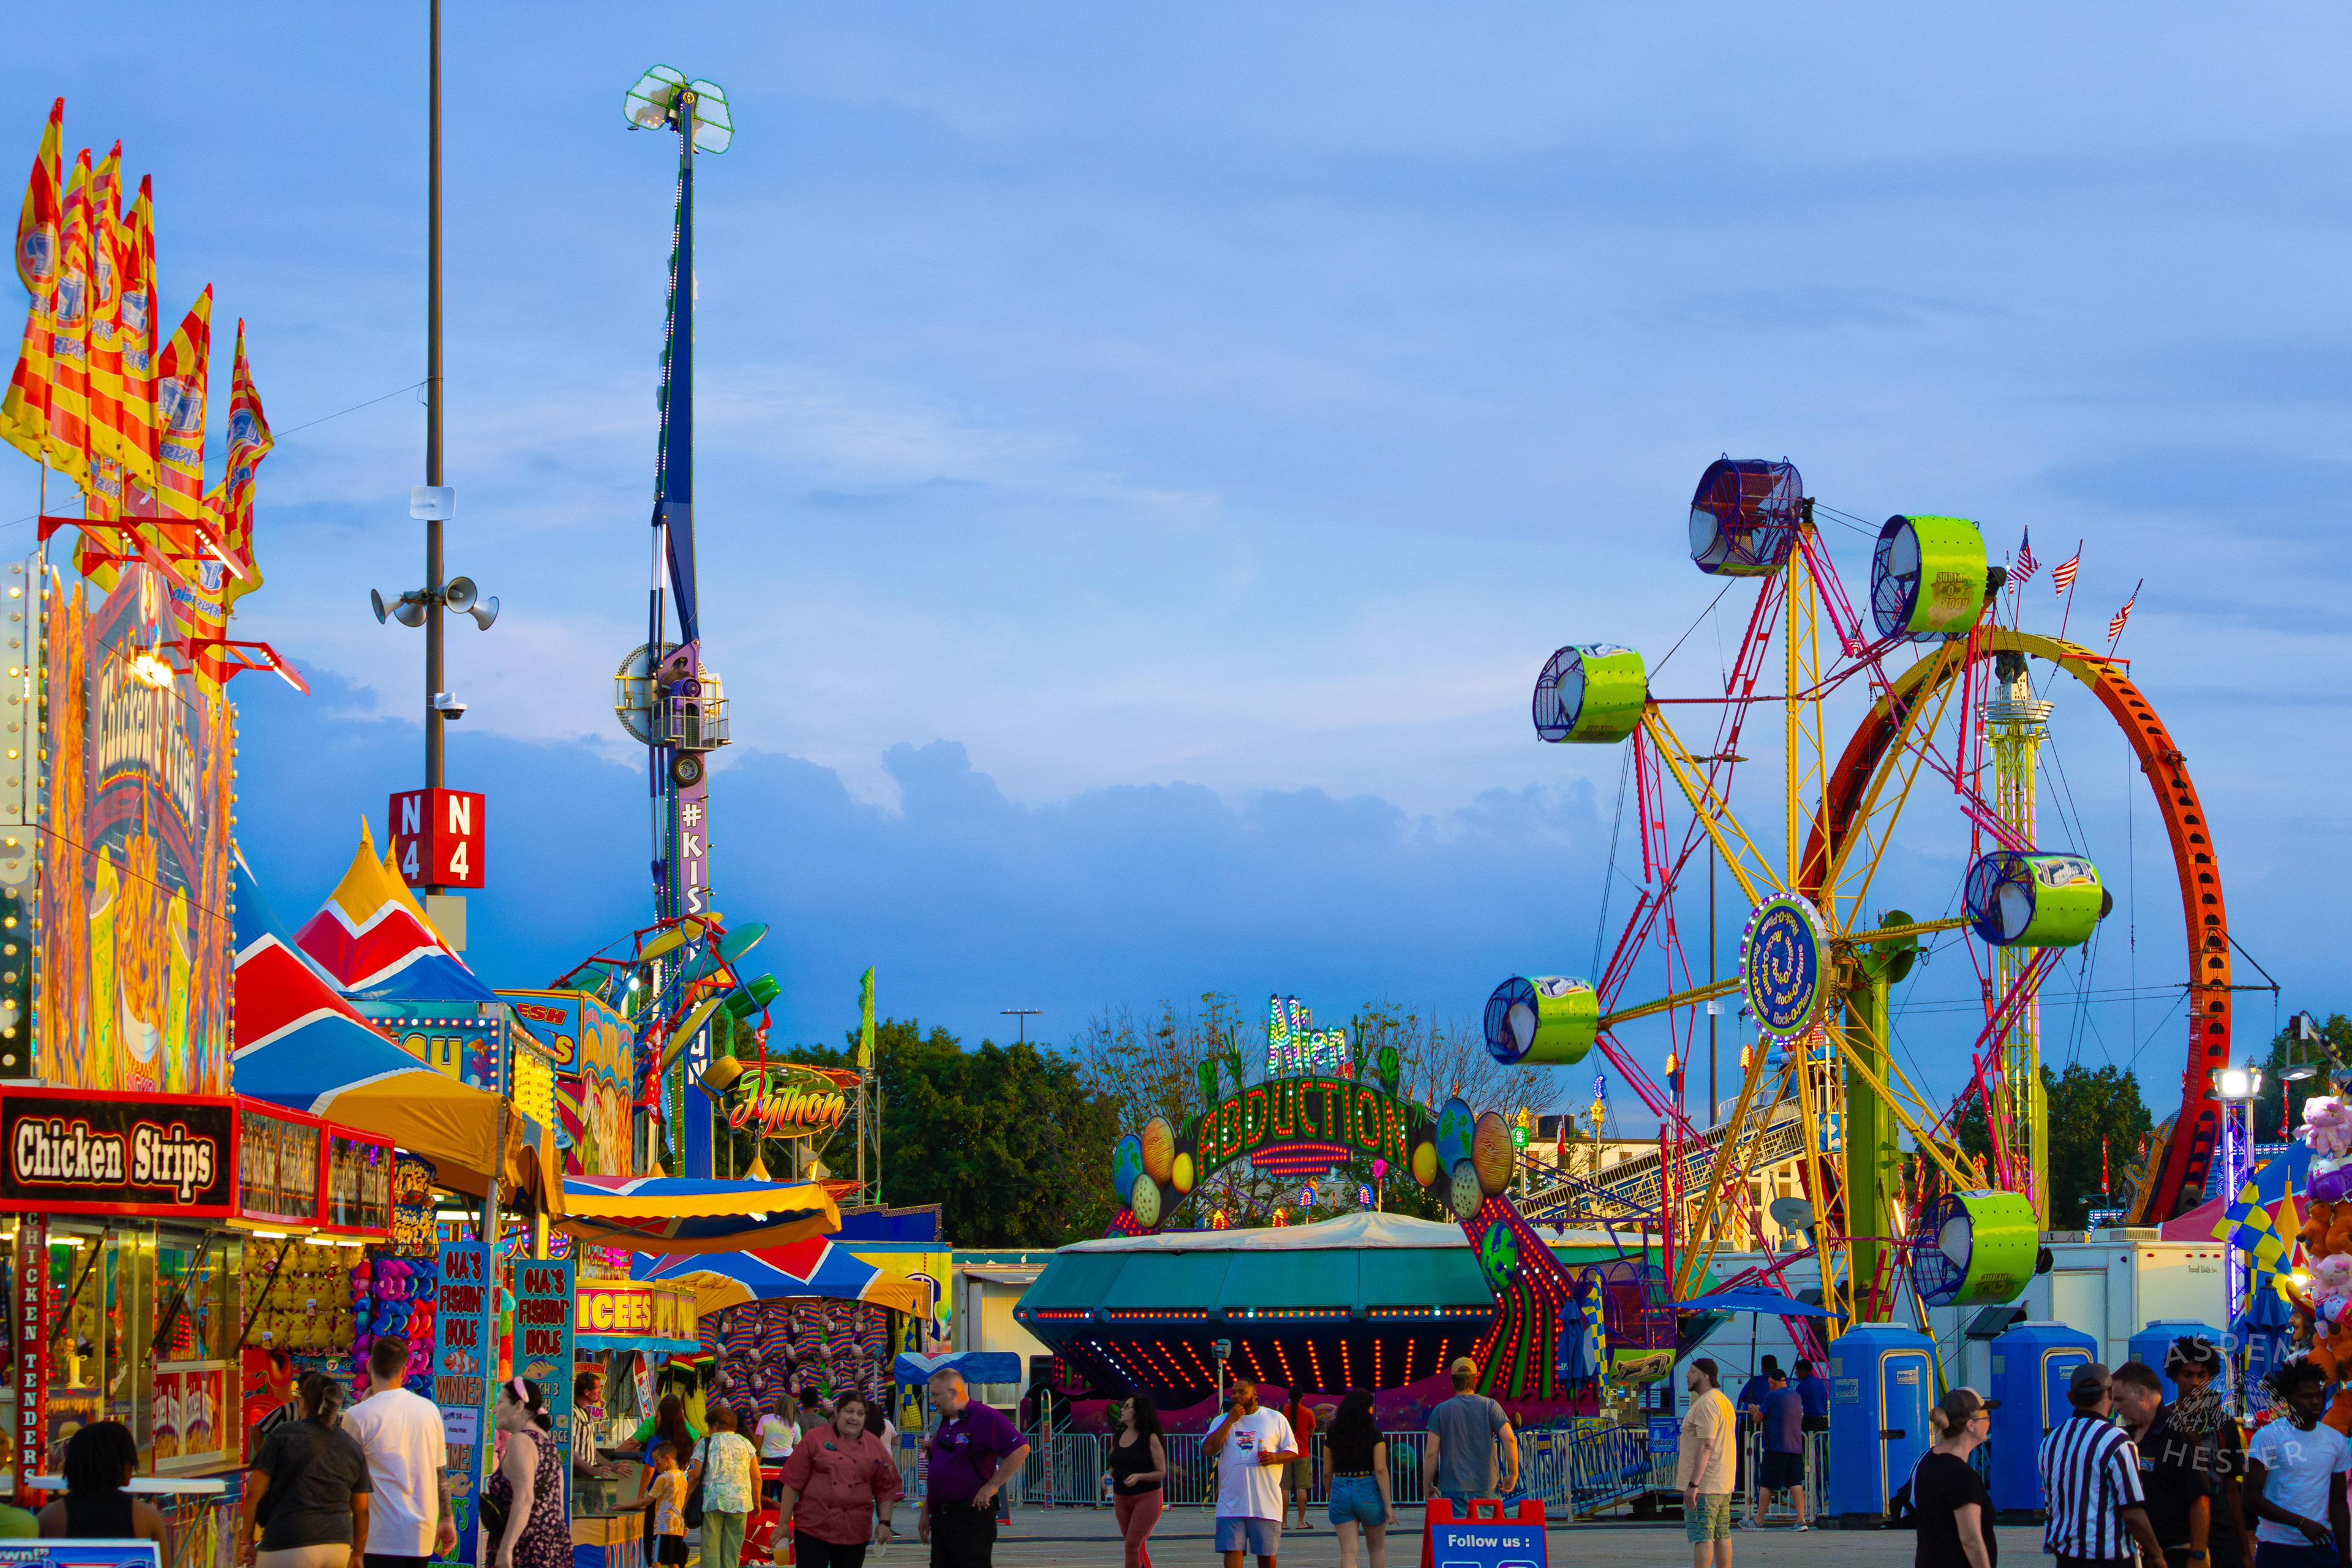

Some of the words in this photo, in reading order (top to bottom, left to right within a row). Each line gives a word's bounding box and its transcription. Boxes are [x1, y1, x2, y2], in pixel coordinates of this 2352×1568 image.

[402, 795, 421, 835] N
[449, 795, 470, 835] N
[402, 841, 420, 880] 4
[450, 842, 469, 881] 4
[516, 1002, 567, 1025] ESH
[1267, 993, 1346, 1076] Alien
[729, 1069, 845, 1139] Python
[1196, 1077, 1409, 1185] ABDUCTION
[17, 1123, 123, 1179] Chicken
[135, 1128, 211, 1199] Strips
[24, 1212, 39, 1341] CHICKEN
[445, 1250, 482, 1281] GIA'S
[524, 1267, 565, 1295] GIA'S
[577, 1292, 652, 1331] ICEES
[445, 1317, 478, 1348] HOLE
[525, 1329, 562, 1356] HOLE
[435, 1375, 484, 1406] WINNER
[552, 1382, 560, 1395] 3
[23, 1353, 37, 1484] TENDERS
[446, 1442, 472, 1471] IME!
[1448, 1534, 1498, 1548] Follow
[1502, 1538, 1521, 1548] us
